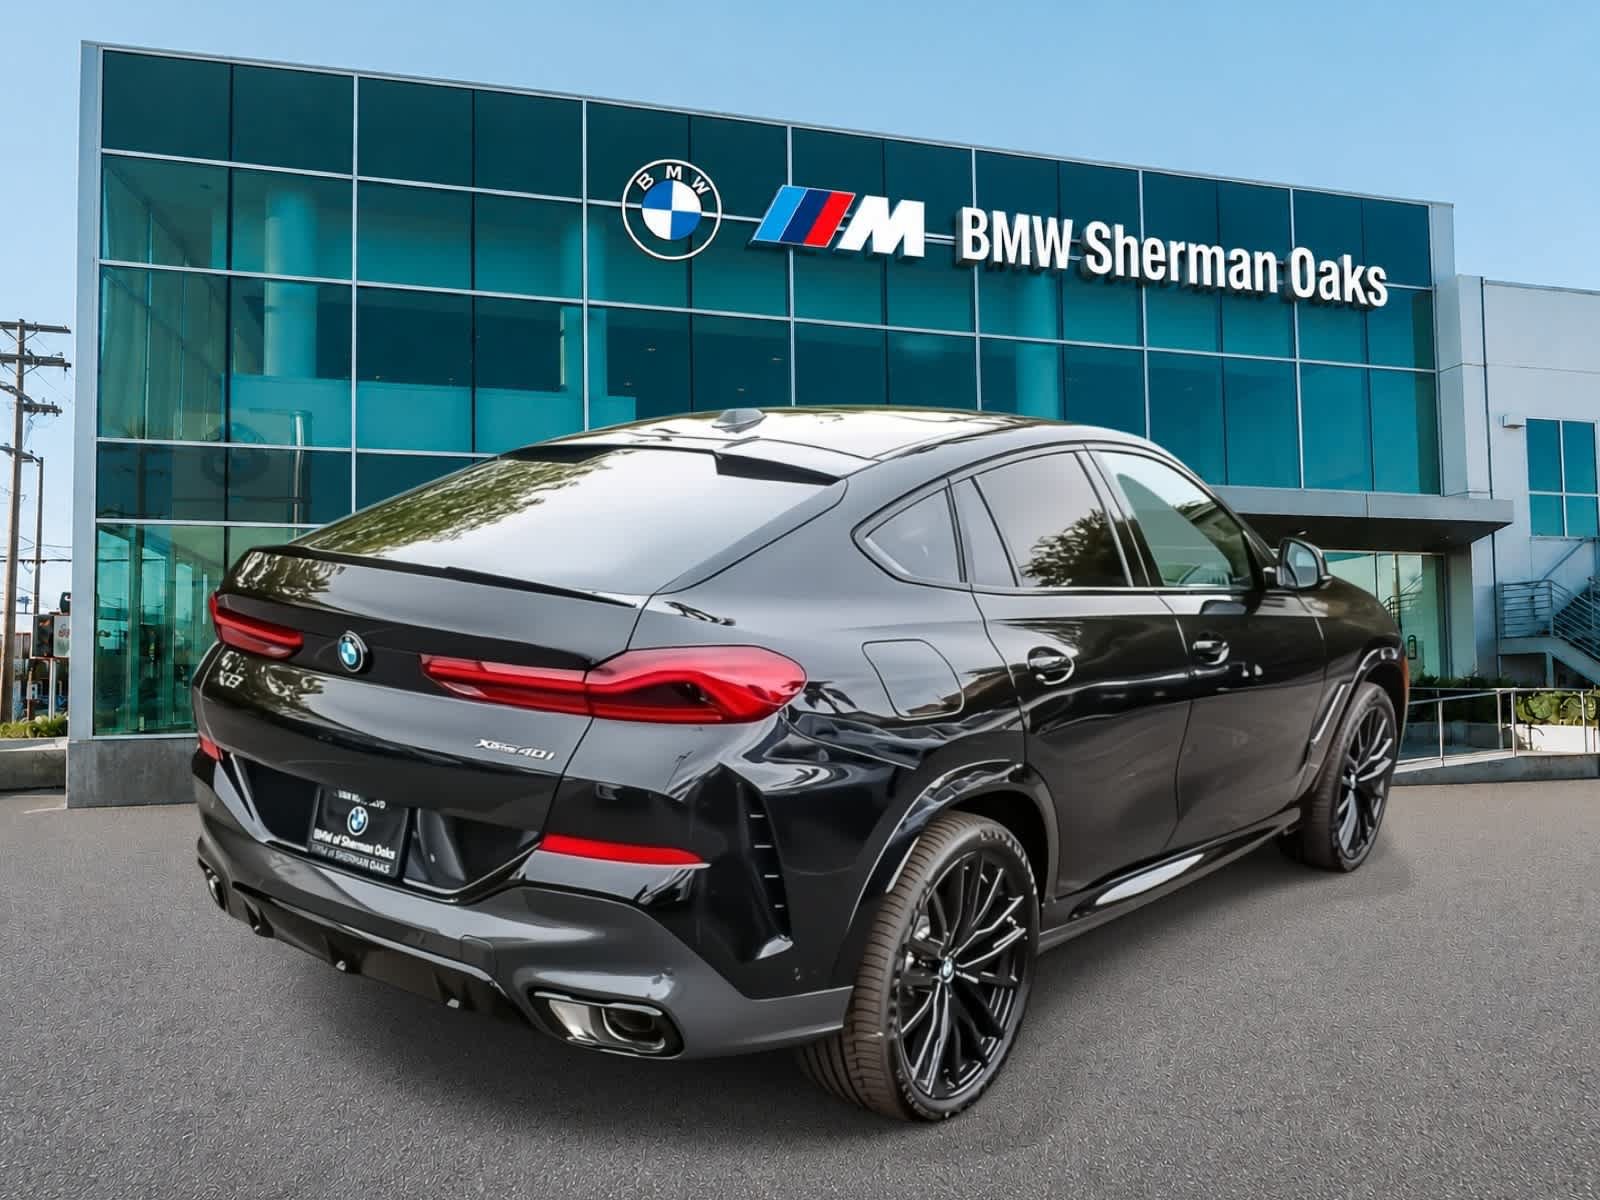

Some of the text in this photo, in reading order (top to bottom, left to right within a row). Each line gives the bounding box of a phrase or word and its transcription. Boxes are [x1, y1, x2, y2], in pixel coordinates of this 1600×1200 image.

[636, 165, 711, 195] BMW
[835, 194, 925, 257] M
[958, 206, 1389, 307] BMW Sherman Oaks
